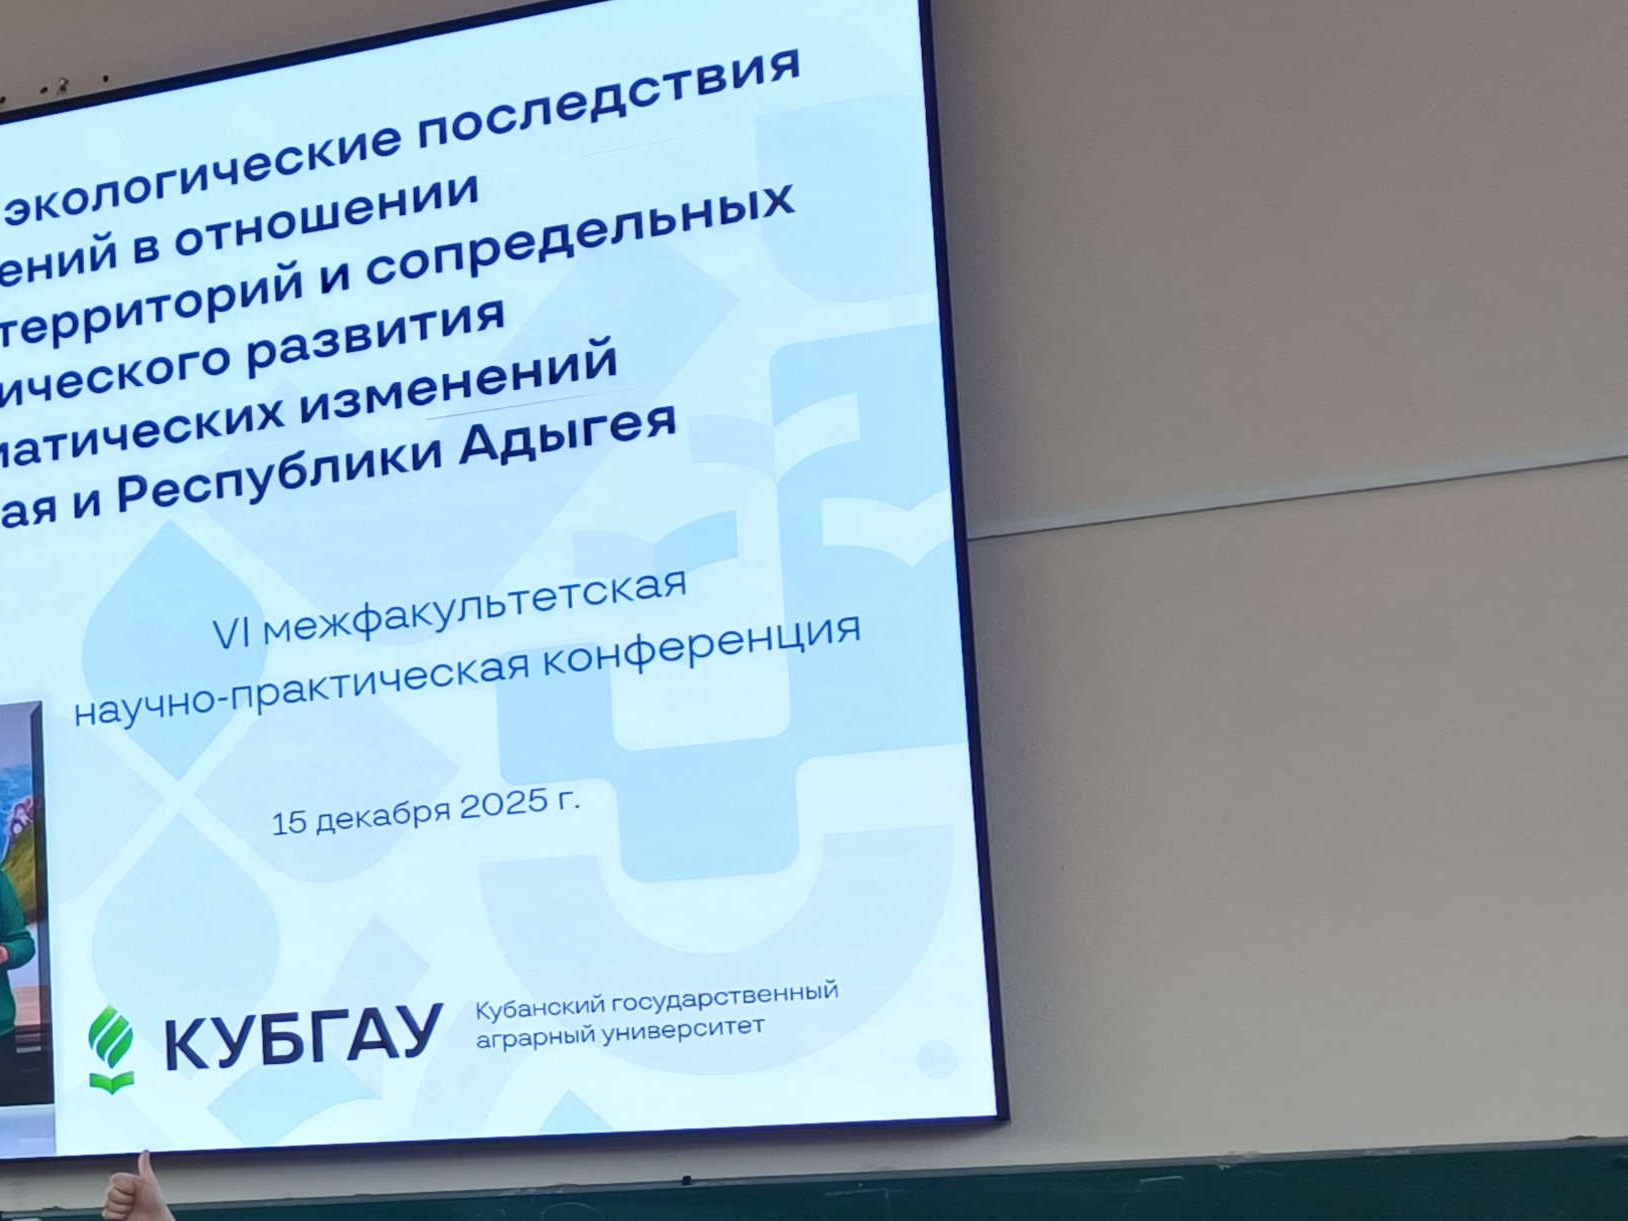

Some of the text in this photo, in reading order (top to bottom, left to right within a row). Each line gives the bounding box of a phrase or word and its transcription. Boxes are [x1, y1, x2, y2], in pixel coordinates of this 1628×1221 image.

[3, 127, 402, 227] экологические
[418, 47, 800, 149] последствия
[133, 235, 161, 265] в
[174, 174, 479, 257] отношении
[319, 262, 350, 295] и
[366, 183, 797, 286] сопредельных
[247, 299, 505, 381] развития
[299, 335, 617, 425] изменений
[72, 489, 101, 520] и
[117, 439, 442, 514] Республики
[458, 405, 677, 467] Адыгея
[212, 570, 687, 650] VI межфакультетская
[74, 615, 861, 731] научно-практическая конференция
[273, 787, 580, 837] 15 декабря 2025 г.
[164, 1002, 445, 1072] КУБГАУ
[476, 978, 839, 1025] Кубанский государственный
[476, 1018, 766, 1053] аграрный университет
